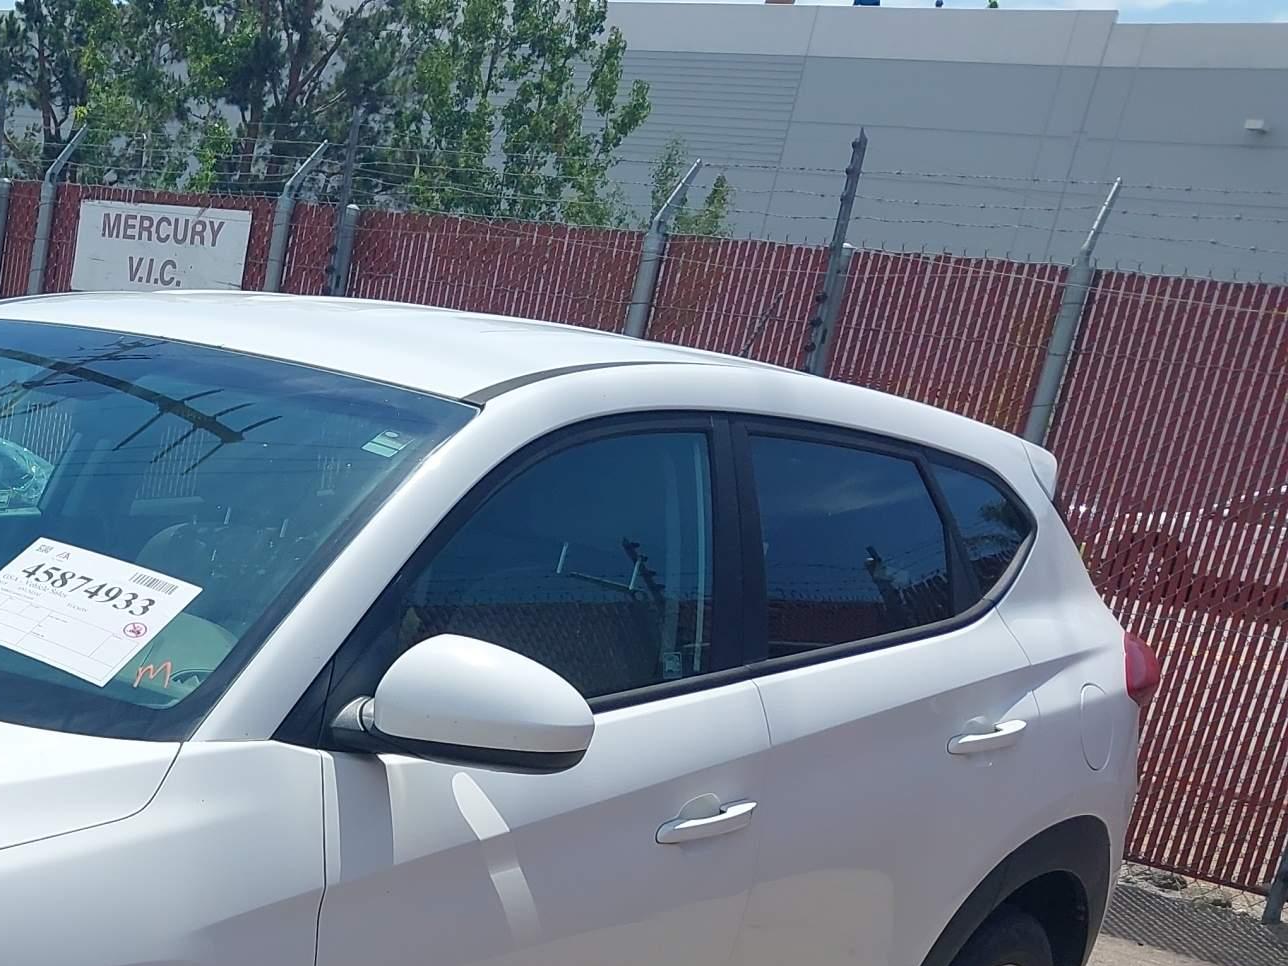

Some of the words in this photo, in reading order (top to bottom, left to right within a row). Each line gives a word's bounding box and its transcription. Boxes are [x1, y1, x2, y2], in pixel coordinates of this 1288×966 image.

[101, 212, 225, 247] MERCURY
[128, 256, 181, 287] V.I.C.
[21, 562, 156, 616] 45874933
